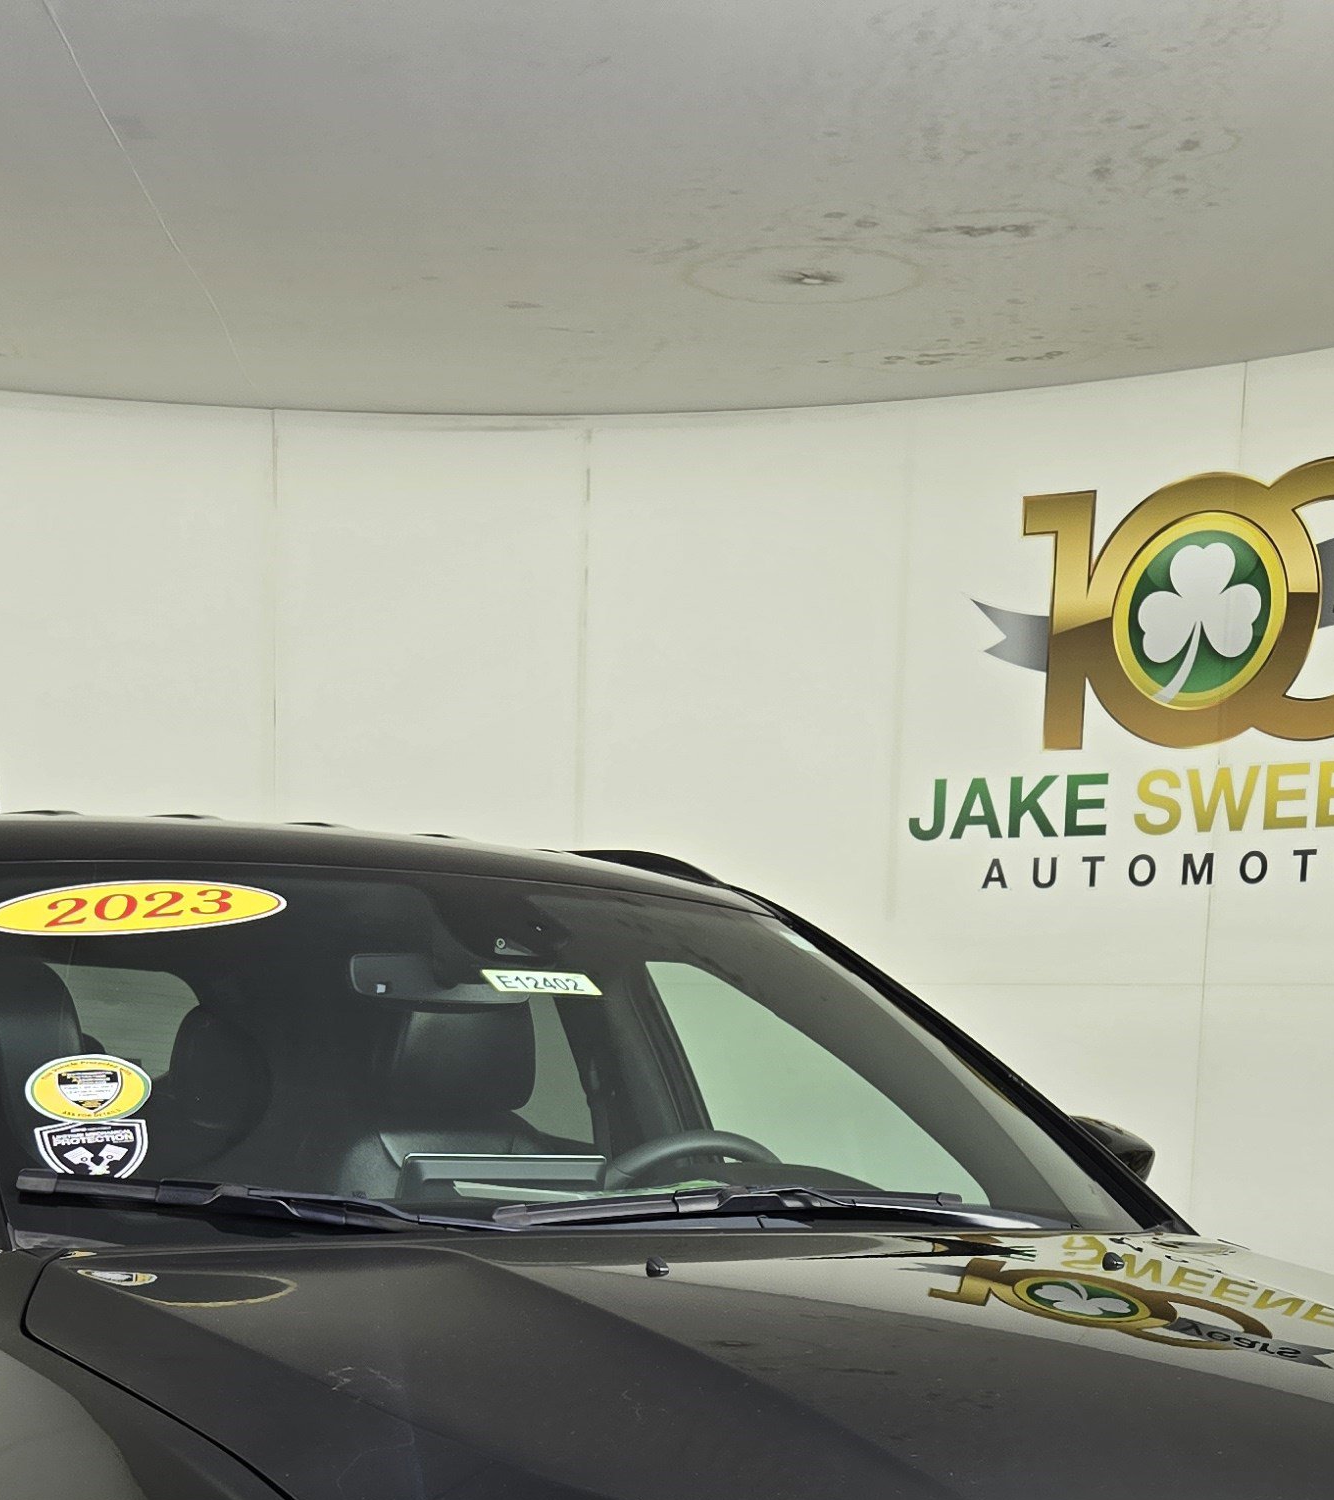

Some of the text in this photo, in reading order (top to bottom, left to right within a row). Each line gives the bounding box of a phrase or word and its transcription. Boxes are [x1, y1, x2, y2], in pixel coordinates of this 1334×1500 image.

[908, 772, 1109, 841] JAKE
[44, 889, 233, 927] 2023
[495, 975, 585, 992] E12402
[52, 1132, 135, 1147] PROTECTION
